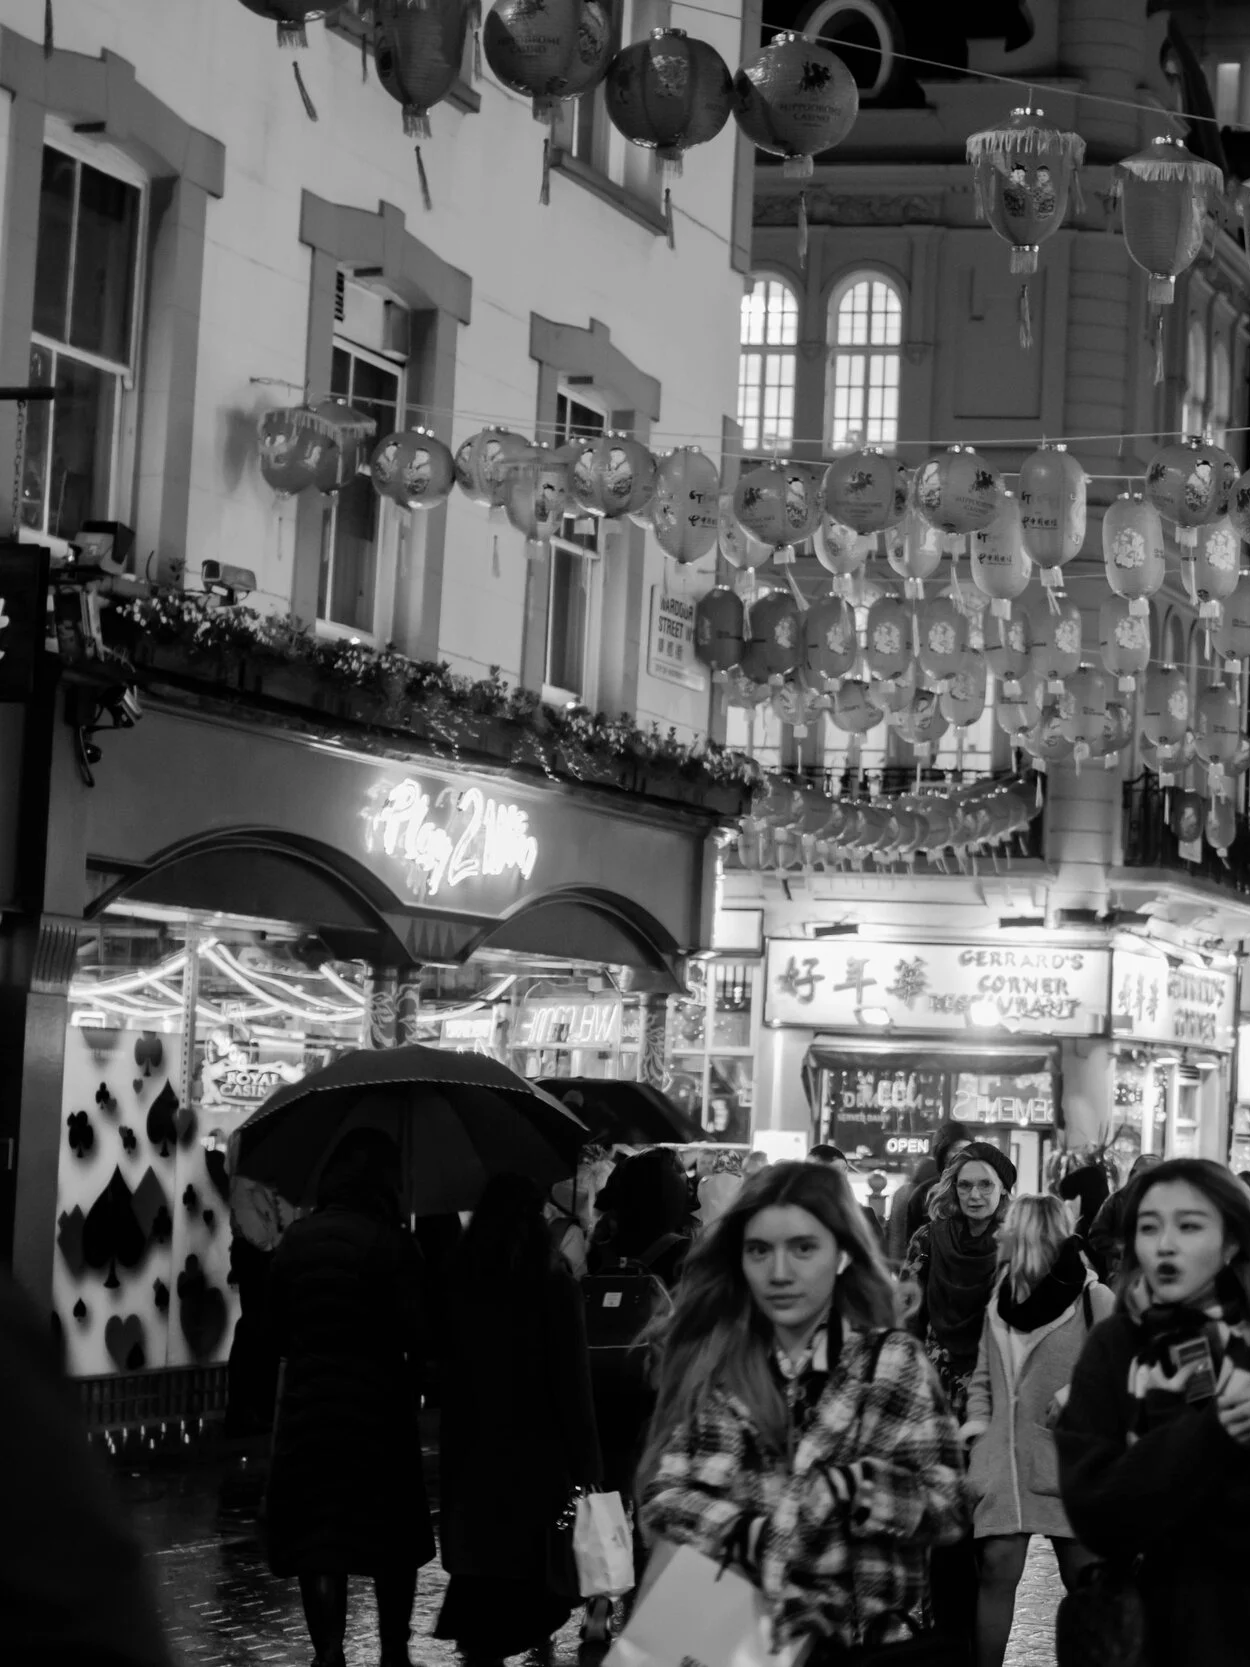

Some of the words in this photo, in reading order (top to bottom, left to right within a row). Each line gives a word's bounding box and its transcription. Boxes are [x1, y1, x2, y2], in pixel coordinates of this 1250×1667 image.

[660, 596, 694, 622] WARDOUR
[658, 615, 684, 640] STREET
[958, 949, 1084, 971] GERRARD'S
[978, 974, 1069, 996] CORNER
[928, 993, 1081, 1020] RESURANT
[219, 1084, 268, 1098] CASIN
[887, 1138, 929, 1154] OPEN
